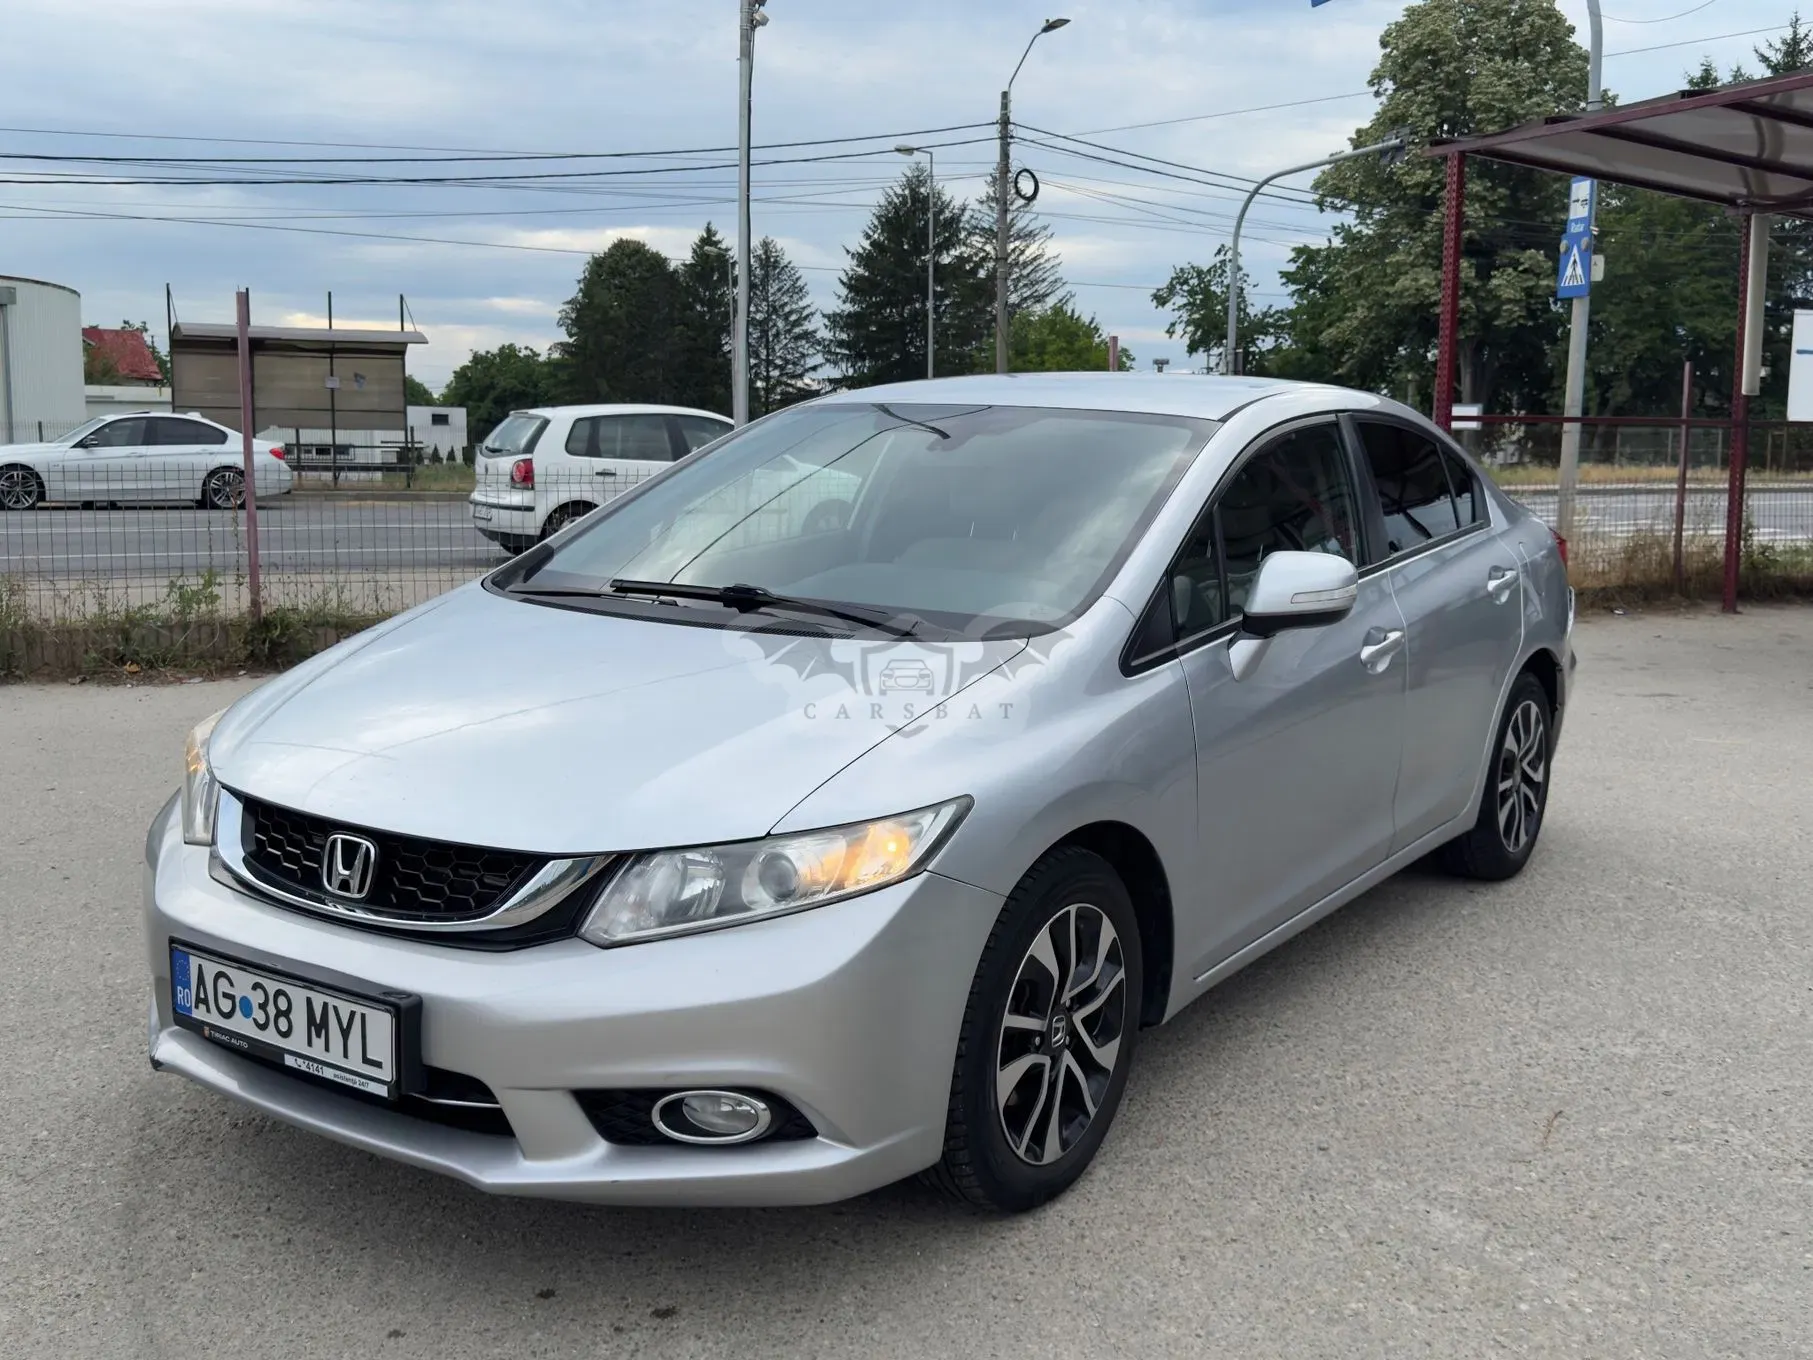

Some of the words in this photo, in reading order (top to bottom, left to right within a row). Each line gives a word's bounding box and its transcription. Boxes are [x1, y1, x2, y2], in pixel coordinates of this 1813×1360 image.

[176, 986, 191, 1008] RO
[194, 963, 237, 1020] AG
[250, 981, 293, 1039] 38
[306, 996, 384, 1070] MYL
[231, 1038, 249, 1049] AUTO
